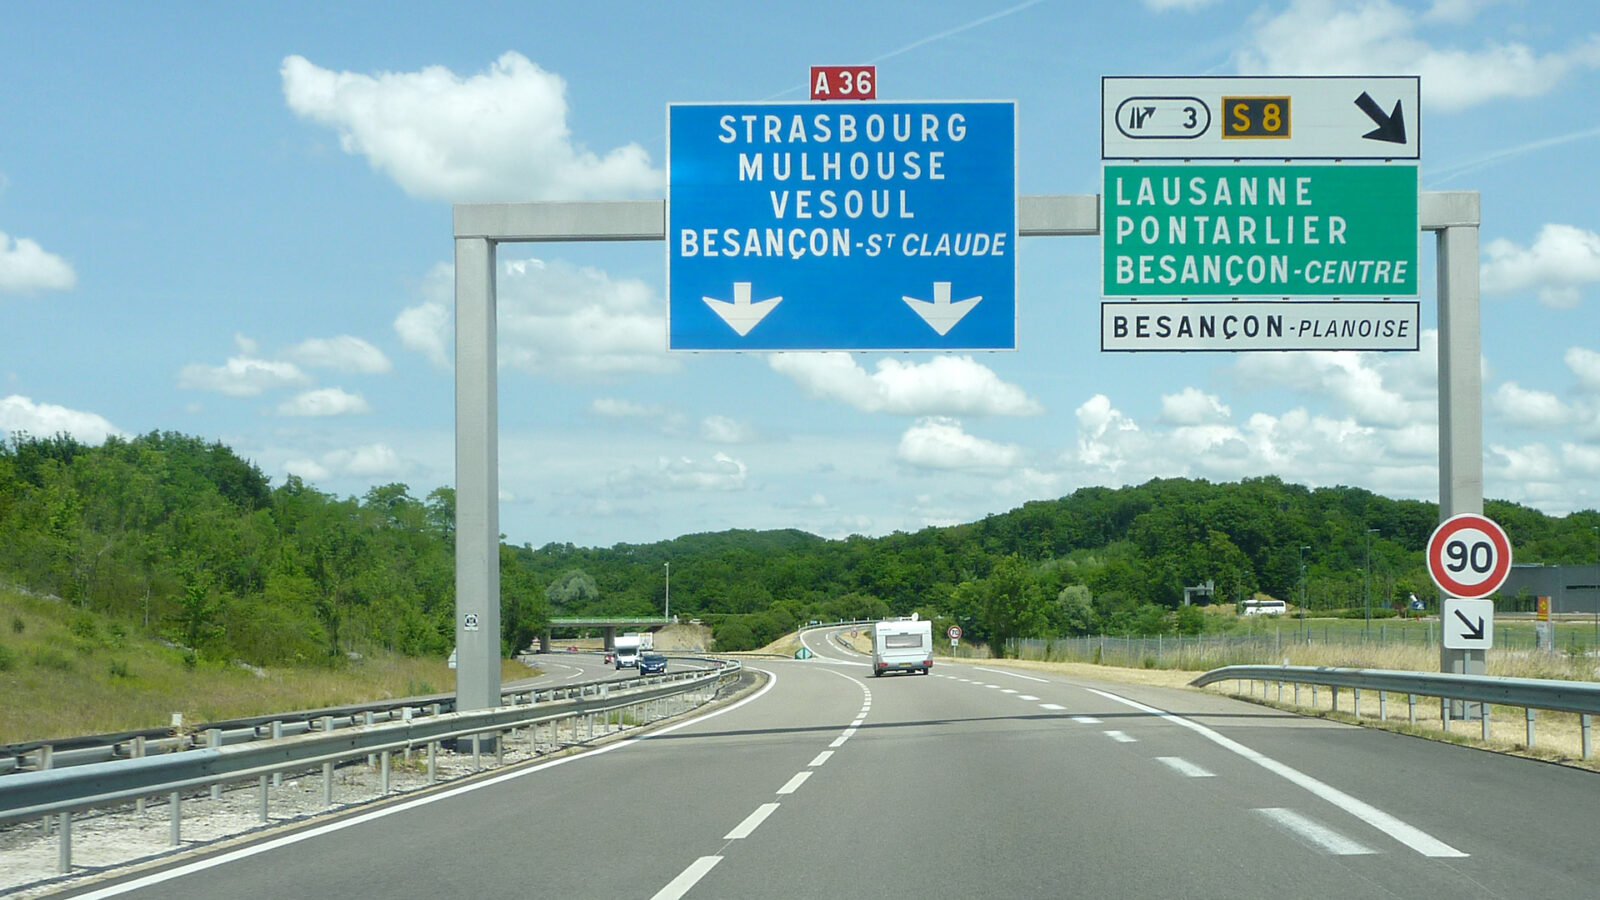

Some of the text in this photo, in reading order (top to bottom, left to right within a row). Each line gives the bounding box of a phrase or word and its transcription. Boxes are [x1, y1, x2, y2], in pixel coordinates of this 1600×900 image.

[814, 70, 872, 95] A 36
[718, 113, 967, 143] STRASBOURG
[1182, 106, 1198, 129] 3
[1231, 103, 1281, 132] S 8
[738, 151, 946, 181] MULHOUSE
[770, 189, 914, 219] VESOUL
[1116, 176, 1312, 206] LAUSANNE
[902, 232, 1007, 256] CLAUDE
[1116, 215, 1347, 245] PONTARLIER
[1446, 540, 1493, 574] 90
